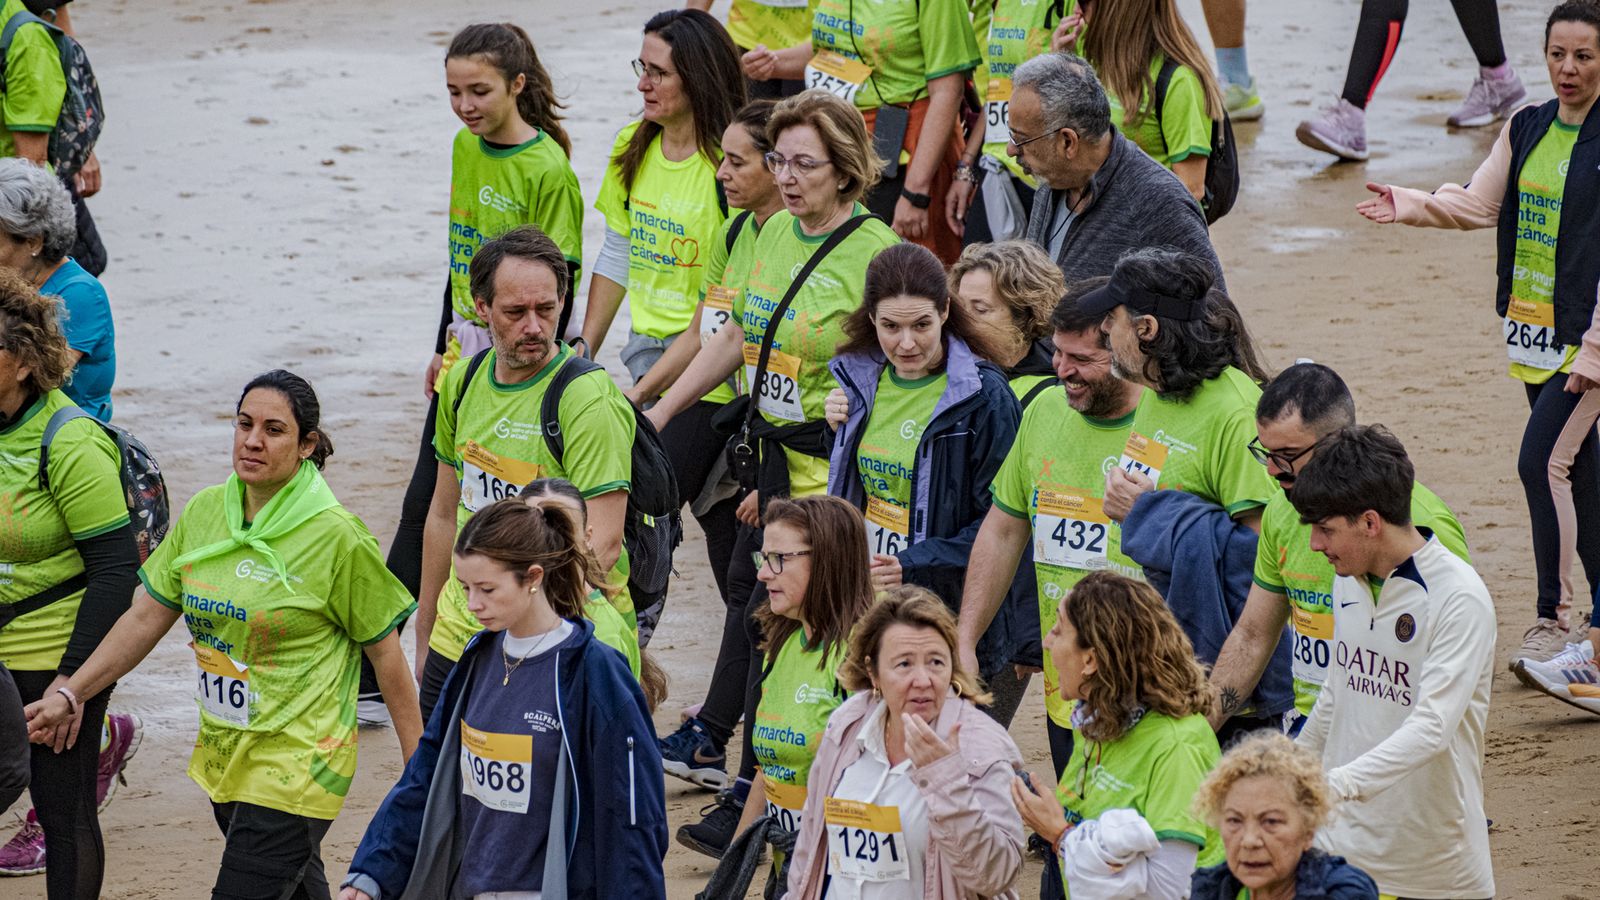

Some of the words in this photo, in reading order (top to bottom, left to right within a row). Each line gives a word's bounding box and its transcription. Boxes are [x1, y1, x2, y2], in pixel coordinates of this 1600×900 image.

[812, 28, 835, 45] ntra
[635, 209, 685, 236] marcha
[1519, 207, 1546, 226] ntra
[630, 226, 657, 246] ntra
[630, 243, 678, 267] cáncer
[743, 310, 769, 330] ntra
[860, 455, 913, 481] marcha
[1051, 518, 1106, 553] 432
[186, 593, 247, 622] marcha
[184, 612, 215, 630] ntra
[1336, 640, 1411, 688] QATAR
[200, 671, 245, 708] 116
[1347, 675, 1411, 707] AIRWAYS
[757, 726, 806, 746] marcha
[753, 743, 777, 760] ntra
[468, 752, 525, 793] 1968
[838, 826, 899, 862] 1291
